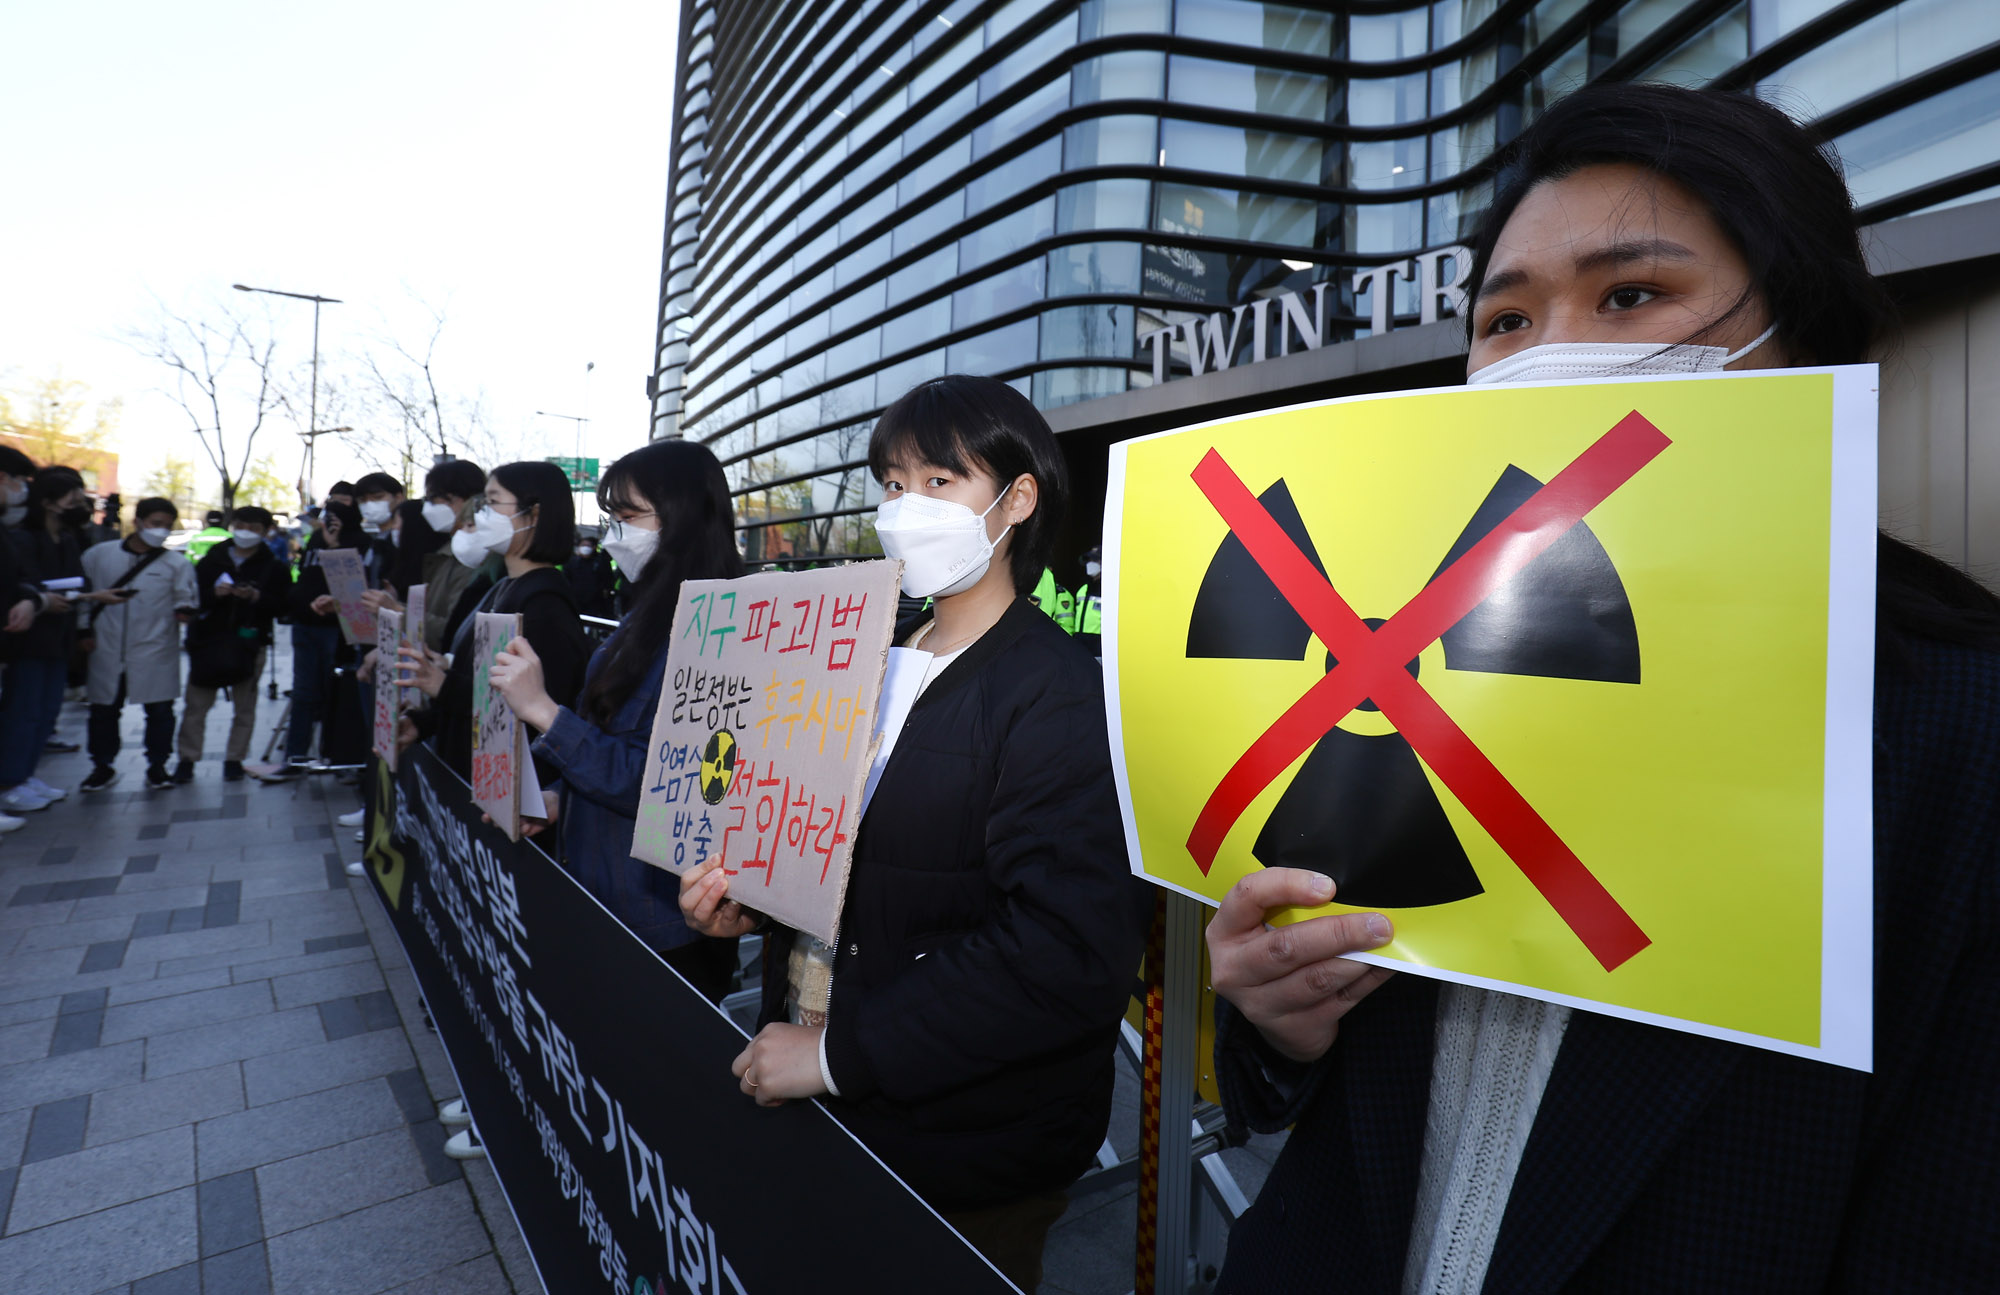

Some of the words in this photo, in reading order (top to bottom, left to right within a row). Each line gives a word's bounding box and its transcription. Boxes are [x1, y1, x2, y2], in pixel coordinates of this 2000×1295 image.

[1140, 281, 1336, 385] TWIN
[683, 592, 737, 659] 지구
[741, 592, 869, 671] 파괴범
[672, 666, 753, 730] 일본정부는
[755, 670, 868, 761] 후쿠시마
[650, 740, 703, 804] 오염수
[722, 748, 848, 888] 철회하라
[673, 809, 714, 866] 방출
[474, 838, 533, 970] 일본
[479, 922, 531, 1054] 방출
[526, 987, 593, 1146] 규탄
[591, 1075, 752, 1295] 기자회
[533, 1101, 632, 1295] 대학생기후행동
